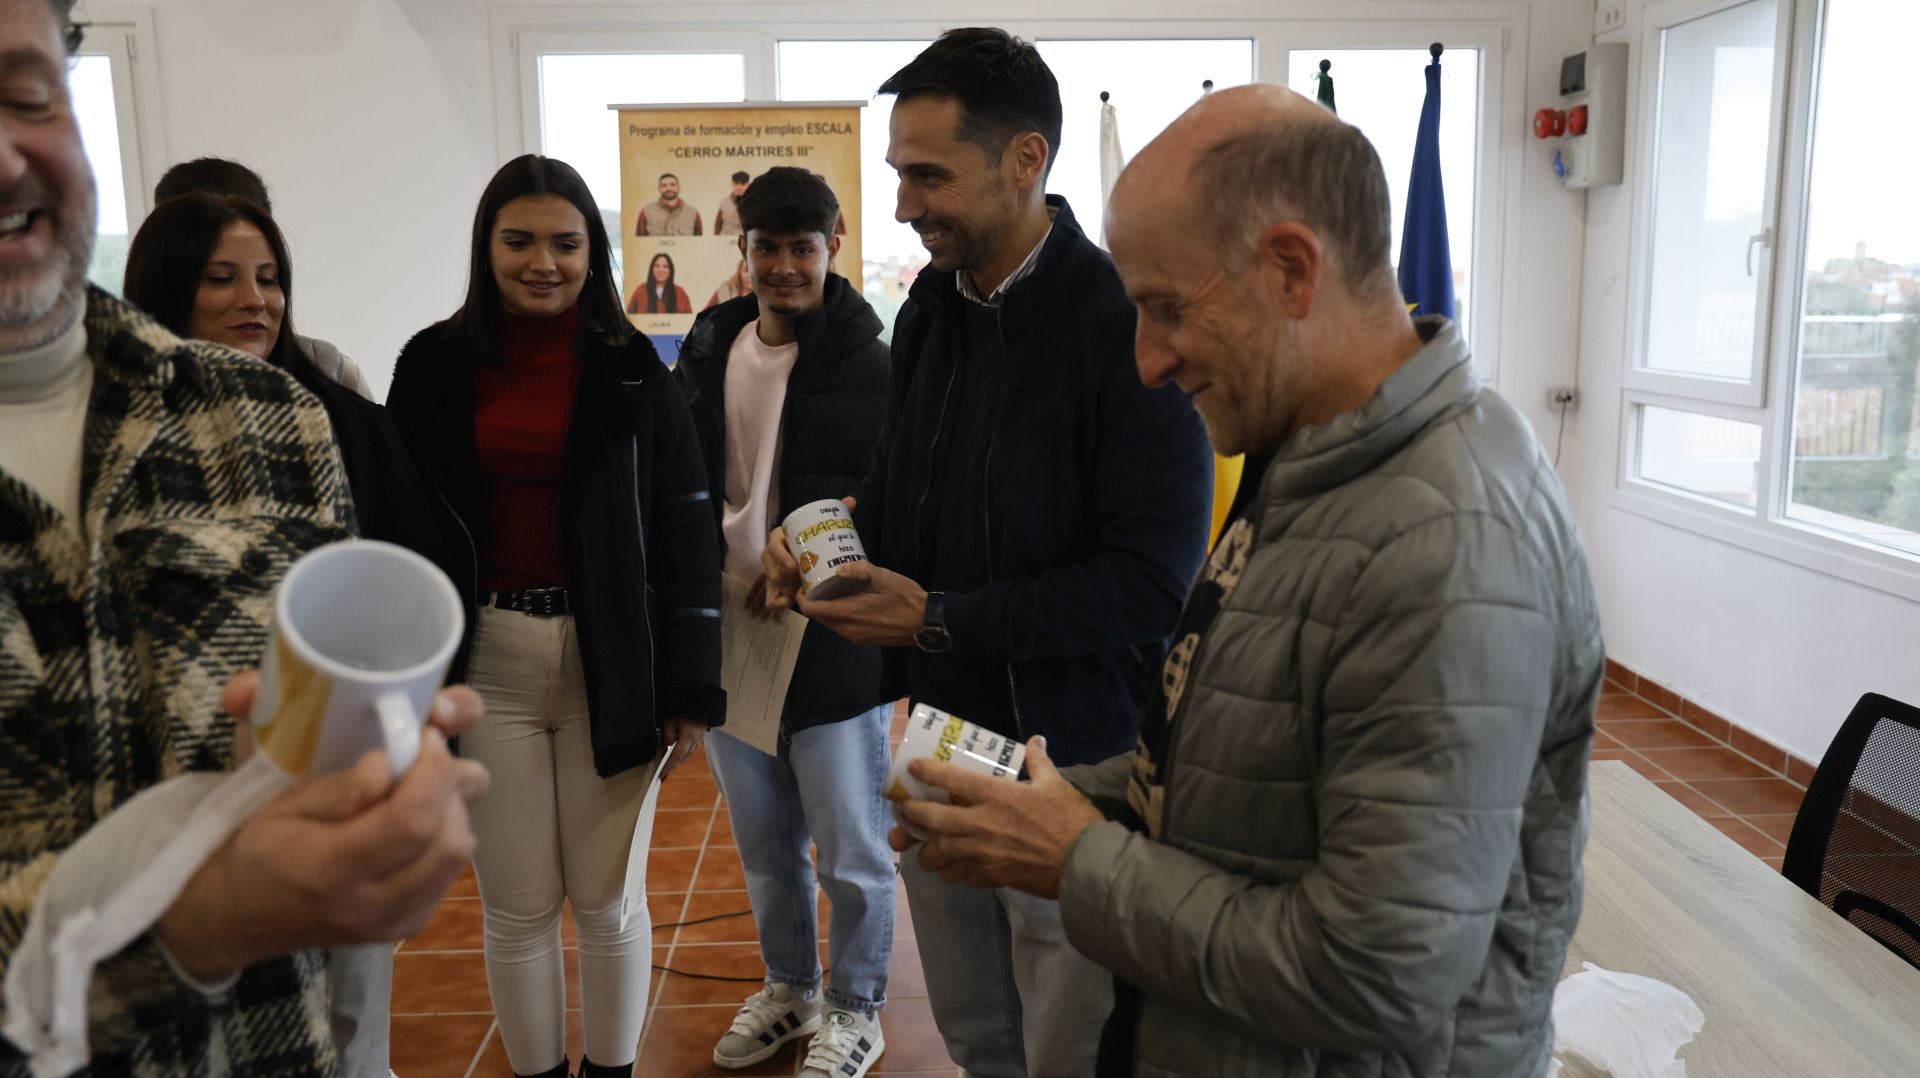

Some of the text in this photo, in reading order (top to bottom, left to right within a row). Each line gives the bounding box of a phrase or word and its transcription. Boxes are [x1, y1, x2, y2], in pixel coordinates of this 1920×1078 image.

[629, 122, 852, 139] Programa de formación y empleo ESCALA
[725, 143, 793, 157] MÁRTIRES
